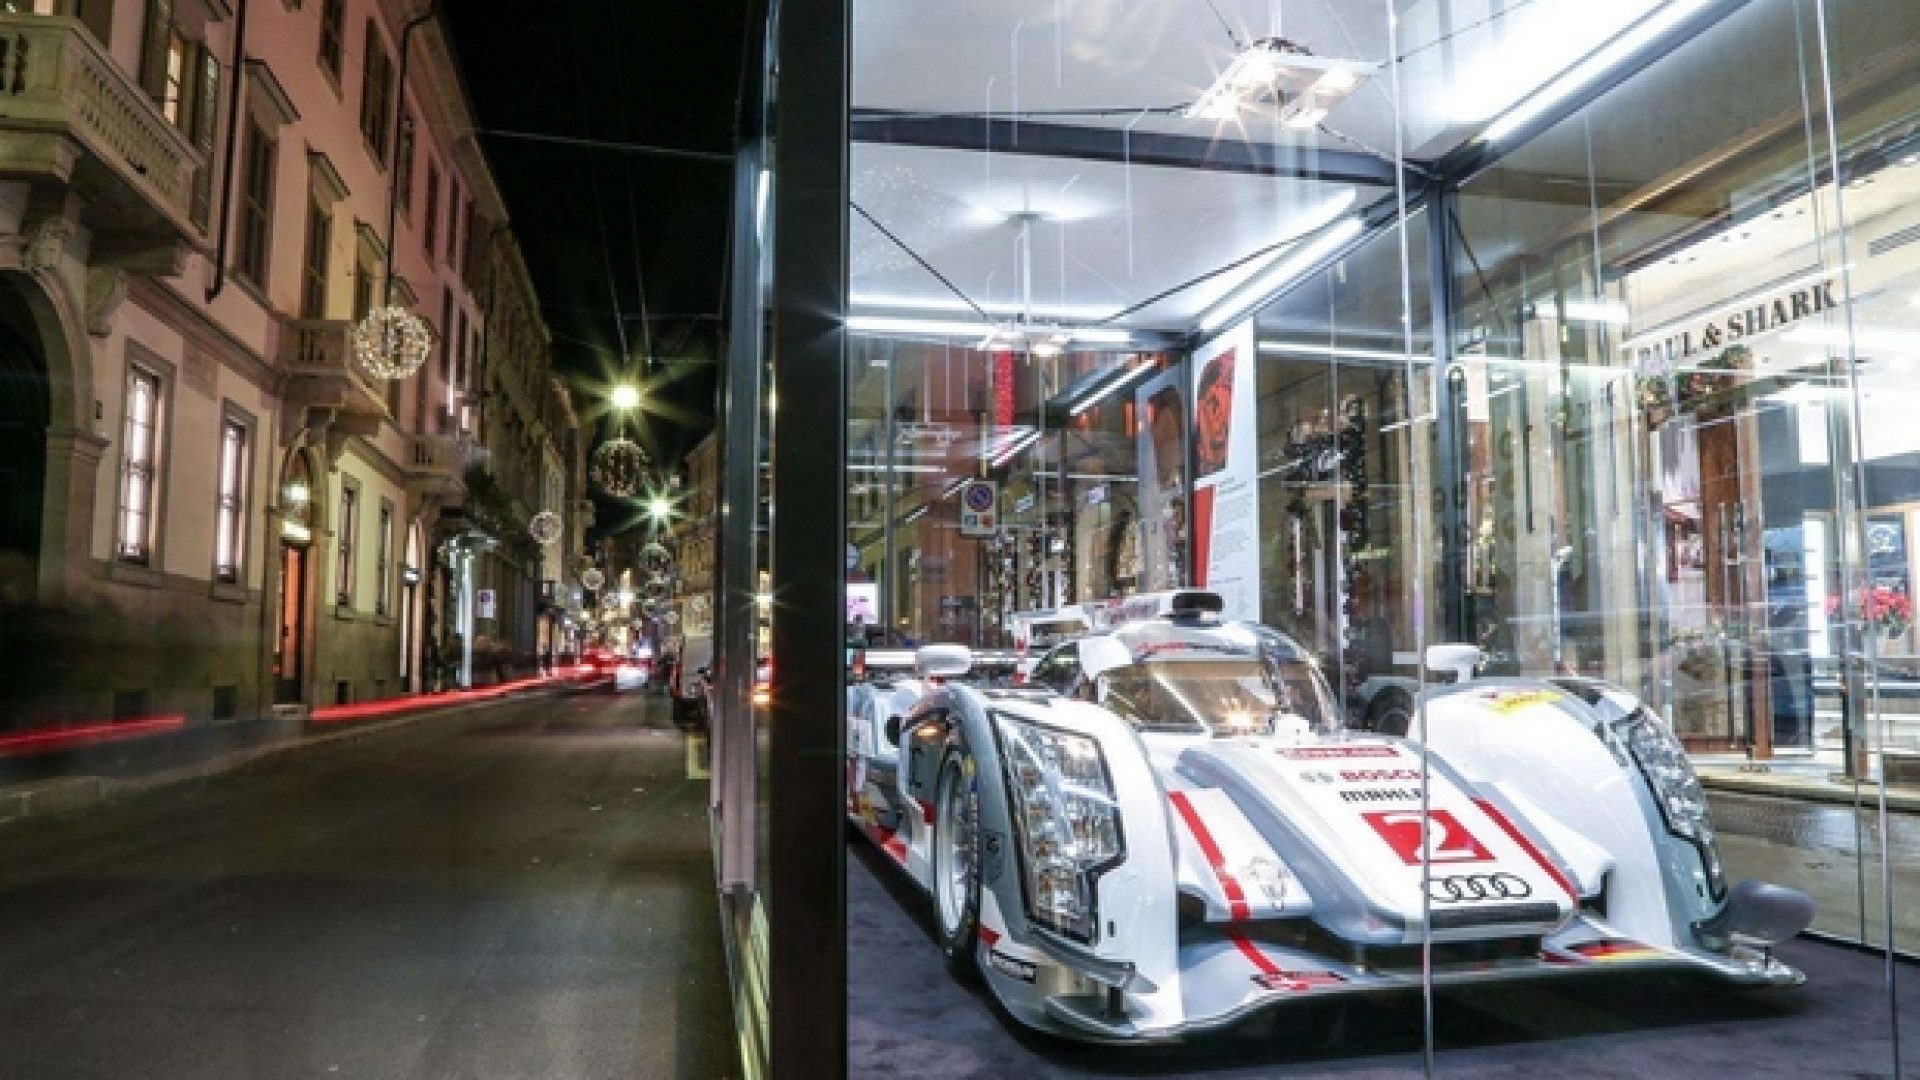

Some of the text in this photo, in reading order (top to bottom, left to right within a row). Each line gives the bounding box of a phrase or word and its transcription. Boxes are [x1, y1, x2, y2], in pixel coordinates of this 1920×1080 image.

[1702, 321, 1723, 349] &
[1727, 278, 1838, 342] SHARK
[1382, 814, 1478, 862] 2
